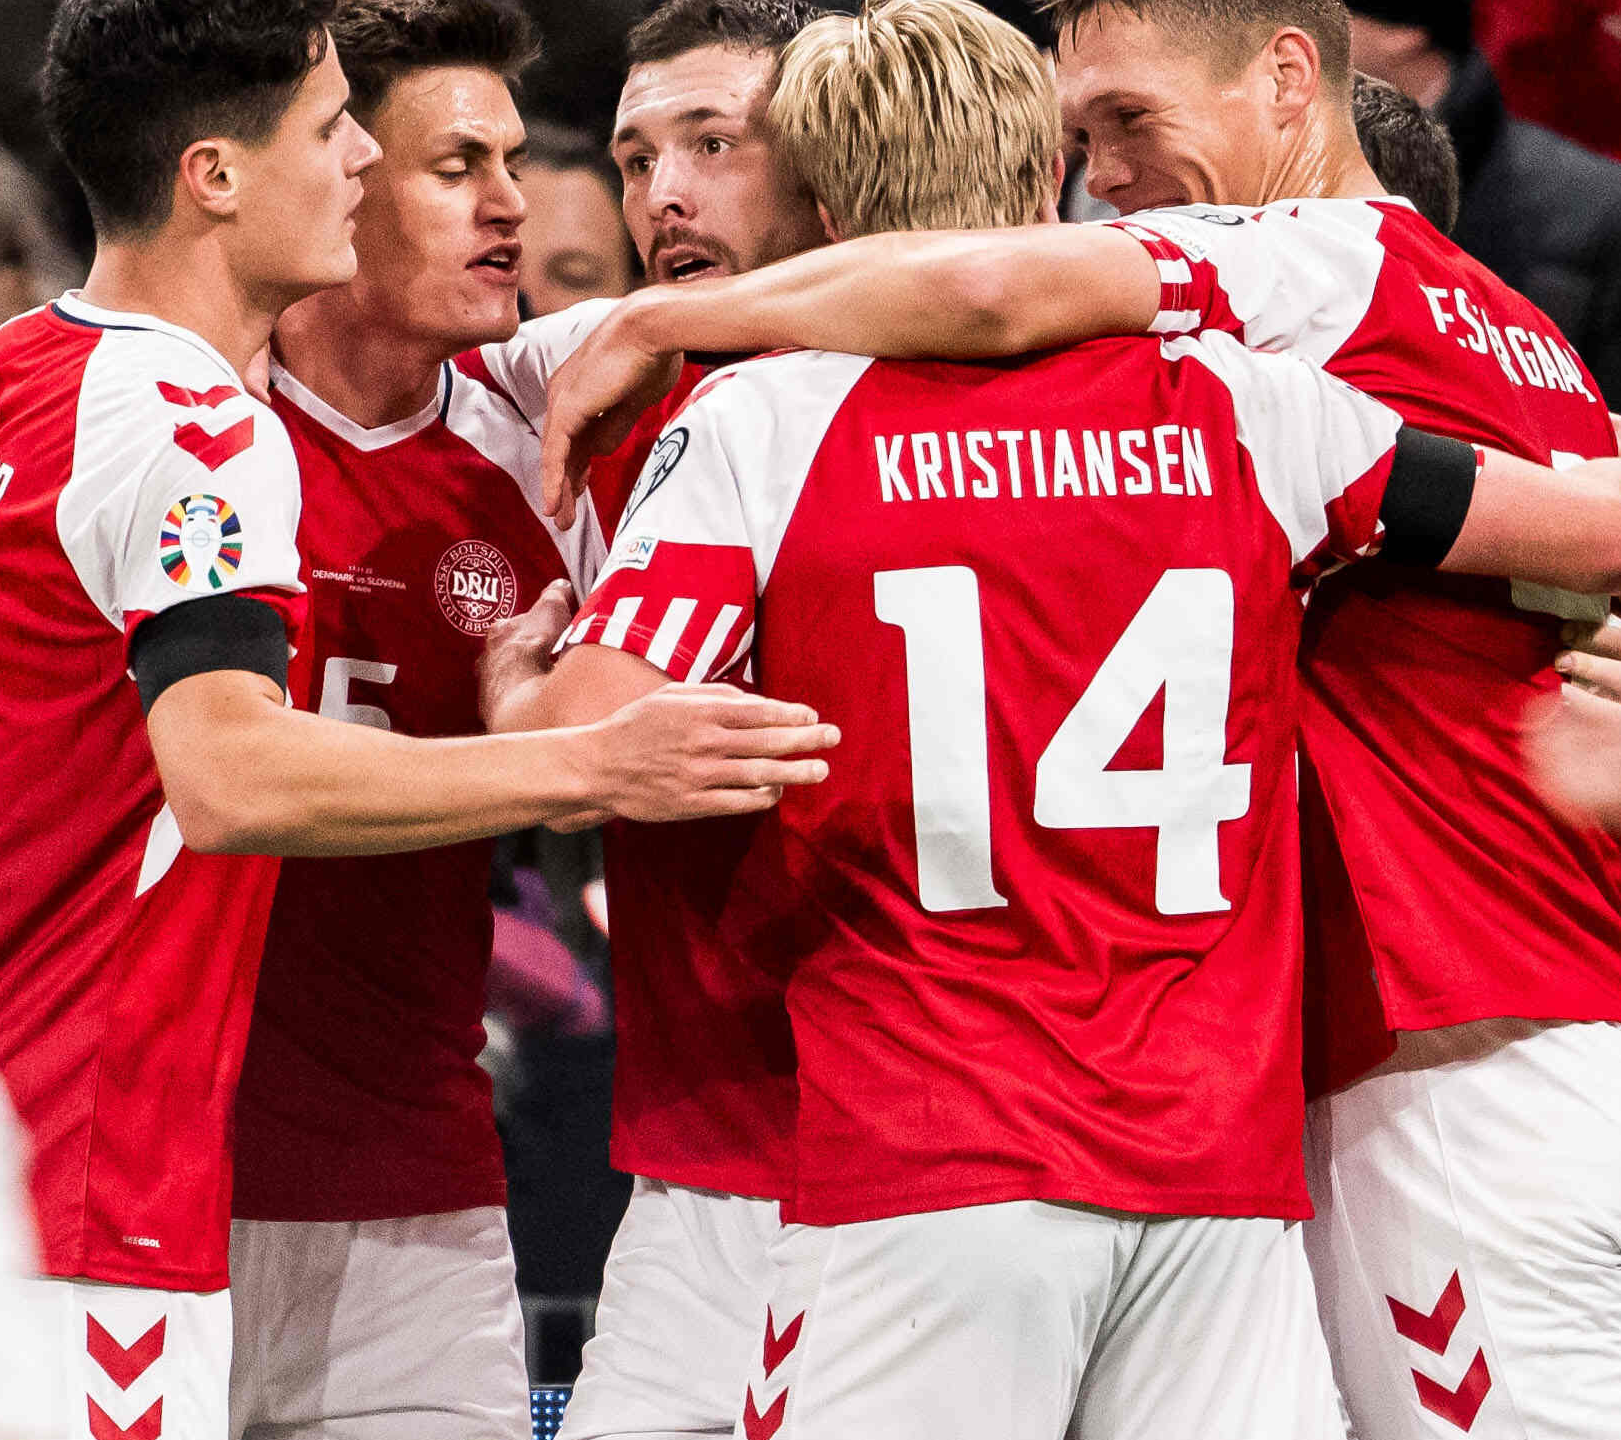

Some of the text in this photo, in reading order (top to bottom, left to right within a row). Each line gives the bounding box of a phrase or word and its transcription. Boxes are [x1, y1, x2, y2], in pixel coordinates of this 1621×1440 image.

[874, 424, 1214, 503] KRISTIANSEN
[312, 569, 355, 583] DENMARK
[366, 576, 407, 590] SLOVENIA
[451, 570, 499, 603] DBU
[874, 565, 1252, 915] 14
